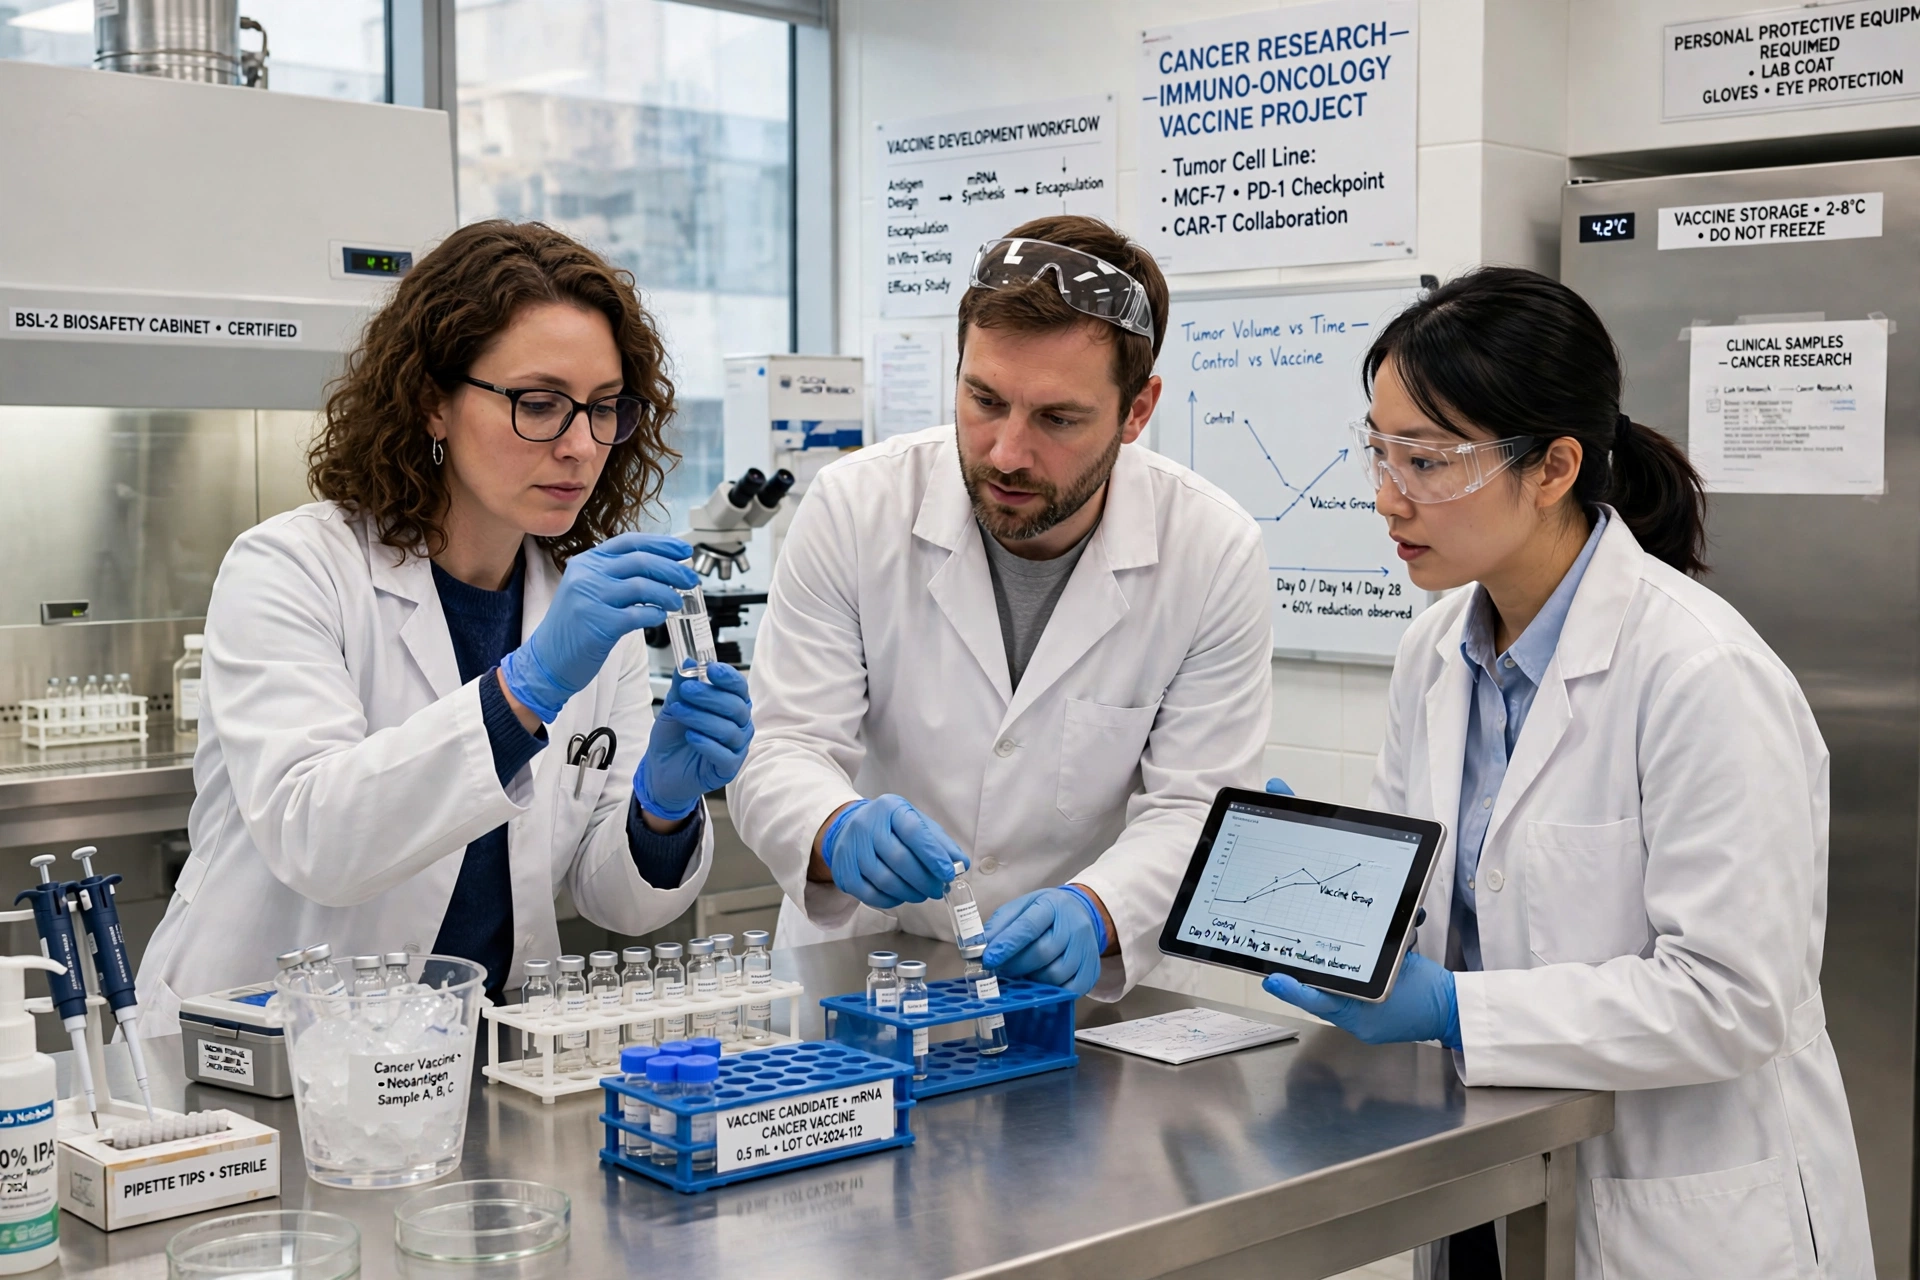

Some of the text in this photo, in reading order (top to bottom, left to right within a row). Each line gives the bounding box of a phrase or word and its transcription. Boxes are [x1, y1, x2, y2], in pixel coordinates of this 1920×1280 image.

[1675, 27, 1754, 50] PERSONAL
[1759, 14, 1855, 40] PROTECTIVE
[1159, 41, 1250, 74] CANCER
[1761, 57, 1834, 78] LAB COAT
[1703, 69, 1904, 104] GLOVES EYE PROTECTION
[1160, 92, 1368, 138] VACCINE PROJECT
[887, 115, 1100, 154] VACCINE DEVELOPMENT WORKFLOW
[1173, 146, 1316, 177] Tumor Cell Line:
[888, 178, 923, 193] Antigen
[967, 171, 998, 185] mRNA
[1036, 176, 1104, 198] Encapsulation
[1174, 171, 1385, 207] MCF-7 PD-1 Checkpoint
[962, 186, 1005, 205] Synthesis
[1174, 206, 1348, 236] CAR-T Collaboration
[1675, 198, 1866, 226] VACCINE STORAGE 2-8°C
[1710, 220, 1826, 242] DO NOT FREEZE
[15, 312, 297, 338] BSL-2 BIOSAFETY CABINET CERTIFIED
[1181, 314, 1346, 342] Tumor Volume vs Time
[1727, 335, 1844, 352] CLINICAL SAMPLES
[1191, 346, 1324, 371] Control vs Vaccine
[1731, 352, 1852, 368] CANCER RESEARCH
[1204, 411, 1235, 425] Control
[1310, 496, 1346, 509] Vaccine
[1277, 578, 1295, 596] Day
[1319, 579, 1338, 597] Day
[1342, 581, 1353, 594] 14
[1365, 581, 1384, 600] Day
[1388, 583, 1401, 596] 28
[1292, 600, 1413, 619] 60% reduction observed
[374, 1053, 456, 1074] Cancer Vaccine
[387, 1071, 448, 1088] Neoantigen
[378, 1092, 420, 1107] Sample
[726, 1088, 882, 1129] VACCINE CANDIDATE mRNA
[762, 1109, 855, 1139] CANCER VACCINE
[34, 1139, 55, 1164] IPA
[736, 1148, 752, 1161] 0.5
[755, 1144, 770, 1158] mL
[782, 1137, 803, 1152] LOT
[124, 1158, 267, 1199] PIPETTE TIPS STERILE
